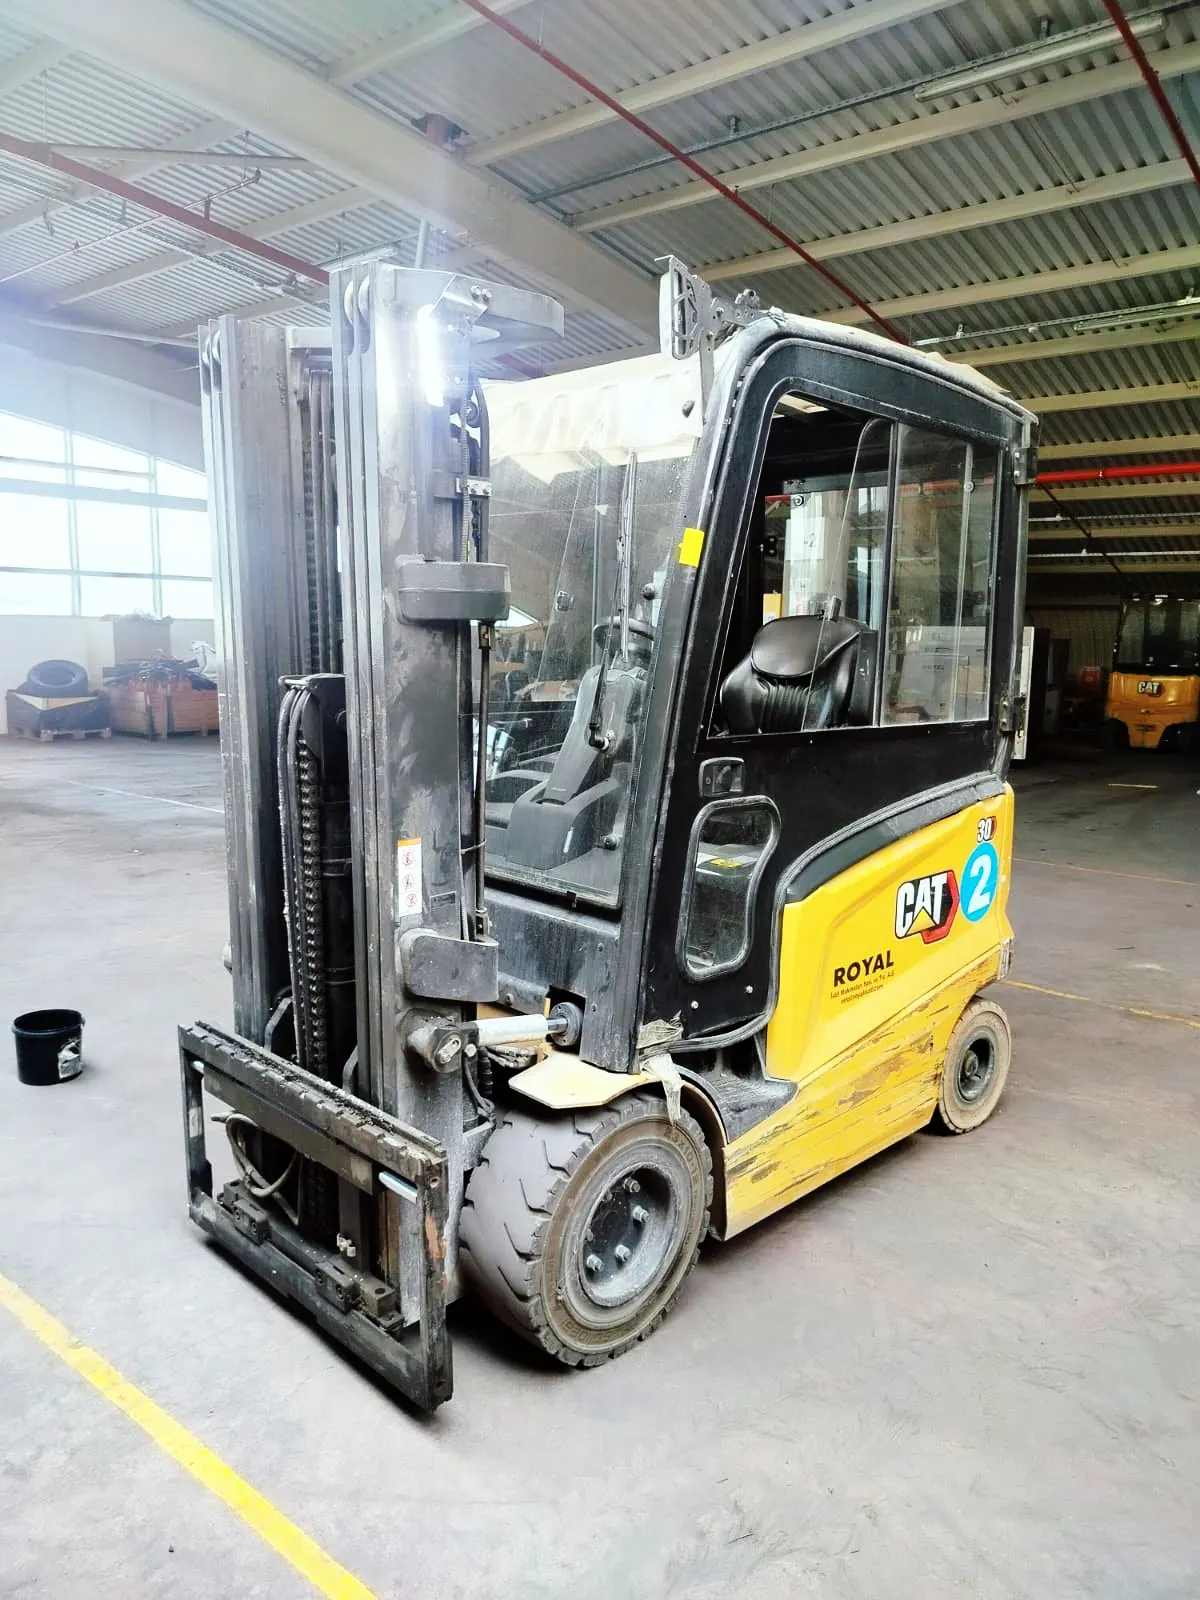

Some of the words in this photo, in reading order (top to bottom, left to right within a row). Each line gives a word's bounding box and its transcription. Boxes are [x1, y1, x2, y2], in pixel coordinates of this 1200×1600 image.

[1138, 681, 1159, 694] CAT
[977, 816, 992, 843] 30
[967, 854, 992, 915] 2
[895, 871, 948, 938] CAT
[833, 950, 894, 987] ROYAL
